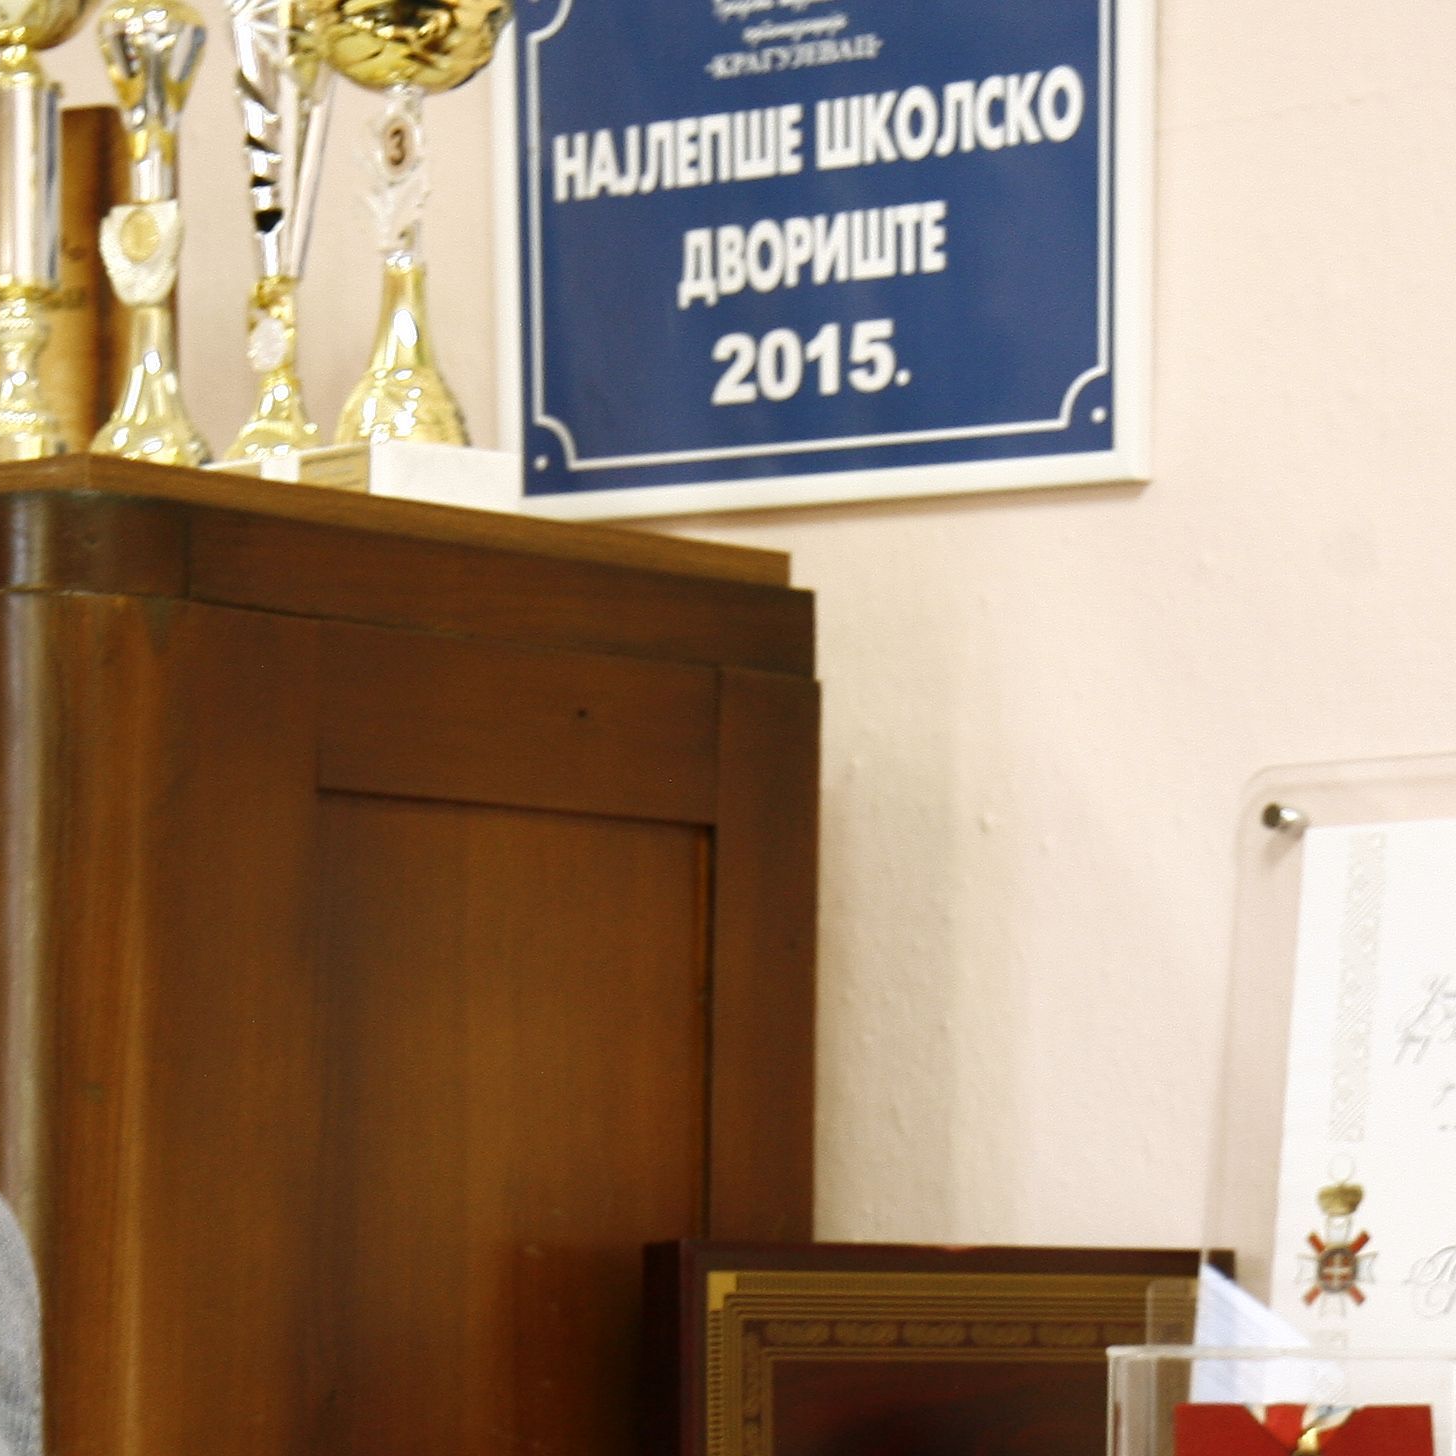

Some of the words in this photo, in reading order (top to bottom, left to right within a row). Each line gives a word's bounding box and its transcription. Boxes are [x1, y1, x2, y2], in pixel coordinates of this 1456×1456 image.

[390, 126, 406, 167] 3
[553, 103, 804, 203] НАЈЛЕПШЕ
[815, 65, 1085, 172] ШКОЛСКО
[677, 200, 948, 310] ДВОРИШТЕ
[711, 318, 912, 407] 2015.
